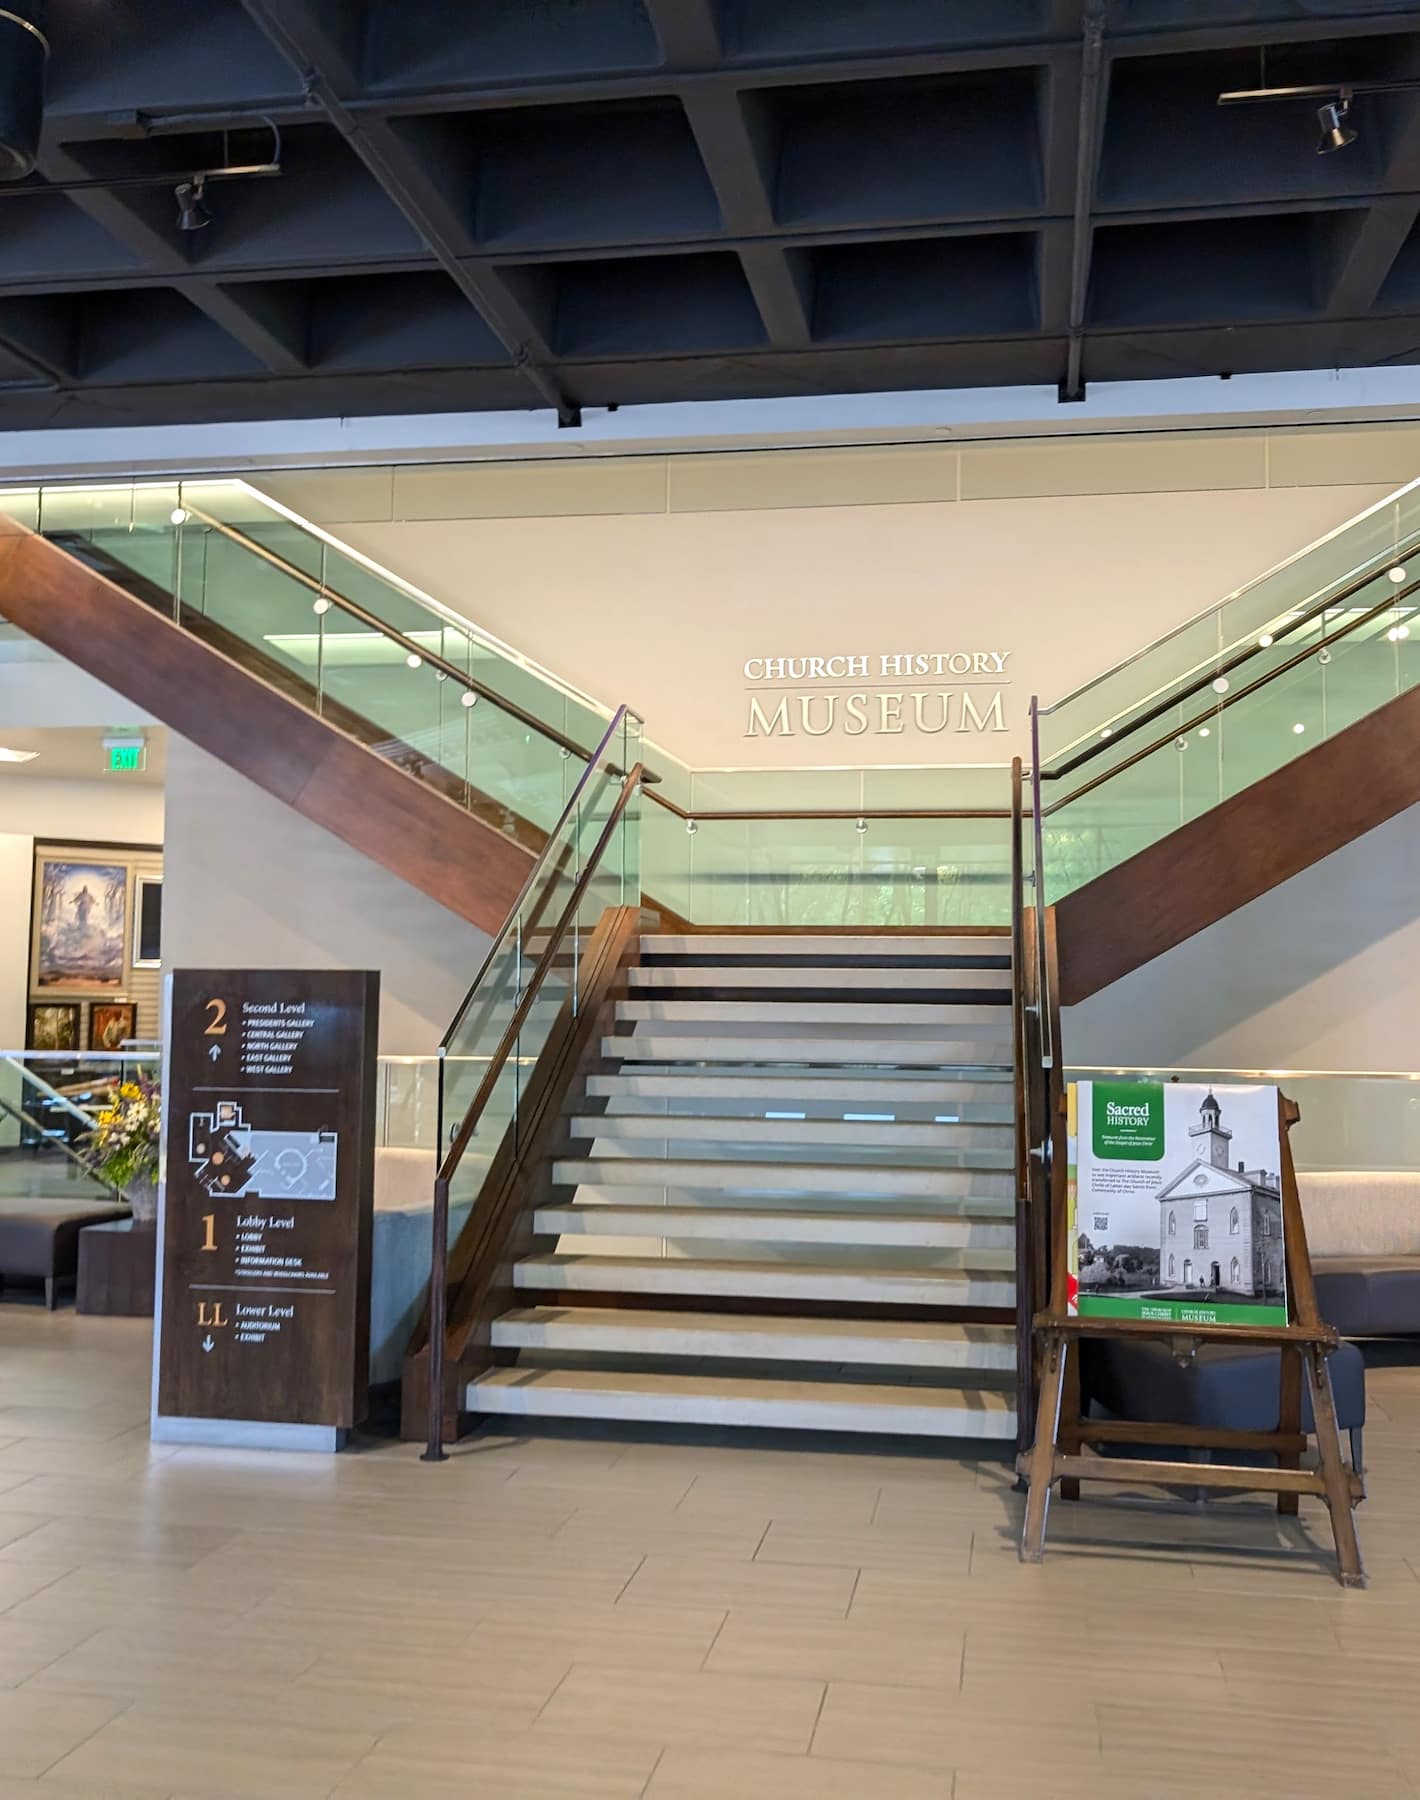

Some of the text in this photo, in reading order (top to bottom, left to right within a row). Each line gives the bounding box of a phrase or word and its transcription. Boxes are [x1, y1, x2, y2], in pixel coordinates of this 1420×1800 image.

[743, 651, 1011, 680] CHURCH HISTORY
[743, 691, 1010, 737] MUSEUM
[111, 748, 138, 769] EXIT
[242, 1001, 306, 1014] Second Level
[203, 998, 228, 1036] 2
[247, 1018, 315, 1028] PRESIDENTS GALLERY
[246, 1030, 304, 1039] CENTRAL GALLERY
[246, 1042, 299, 1051] NORTH GALLERY
[246, 1053, 292, 1063] EAST GALLERY
[245, 1065, 294, 1075] WEST GALLERY
[1106, 1101, 1150, 1117] Sacred
[1106, 1116, 1150, 1126] HISTORY
[236, 1215, 295, 1230] Lobby Level
[201, 1214, 218, 1250] 1
[240, 1232, 263, 1242] LOBBY
[240, 1244, 266, 1254] EXHIBIT
[240, 1256, 303, 1267] INFORMATION DESK
[196, 1302, 229, 1327] LL
[235, 1303, 295, 1318] Lower Level
[1181, 1313, 1216, 1323] MUSEUM
[240, 1321, 281, 1332] AUDITORIUM
[239, 1333, 266, 1344] EXHIBIT
